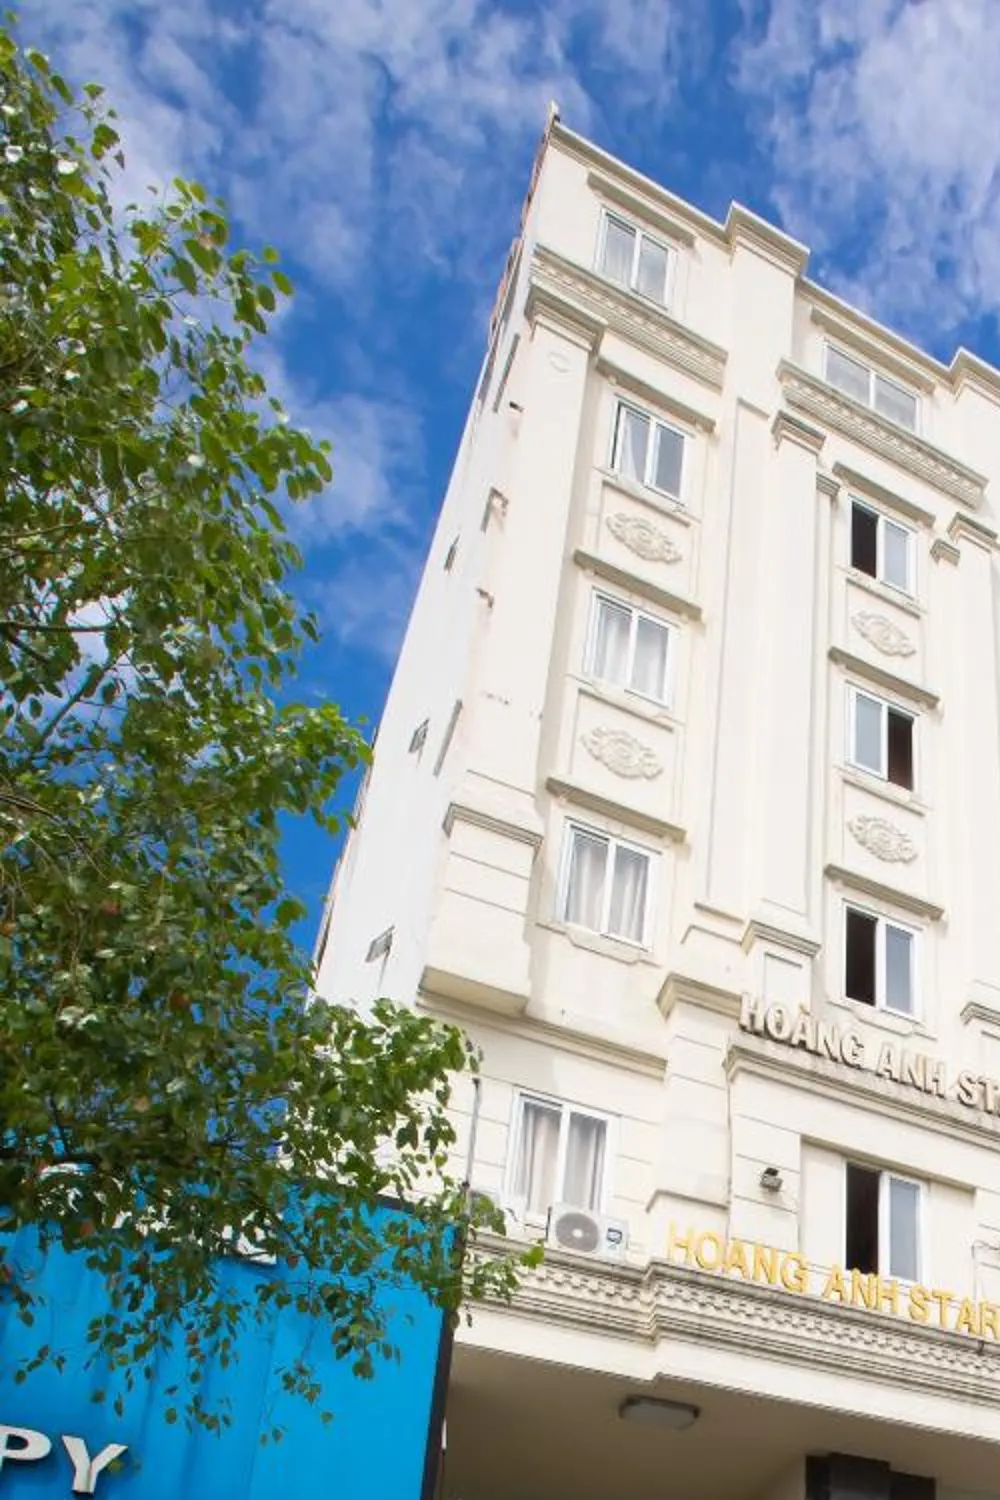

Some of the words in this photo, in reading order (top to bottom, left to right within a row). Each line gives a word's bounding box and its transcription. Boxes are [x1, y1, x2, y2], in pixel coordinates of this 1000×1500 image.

[738, 991, 866, 1070] HOÀNG
[875, 1041, 947, 1099] ANH
[821, 1263, 898, 1315] ANH
